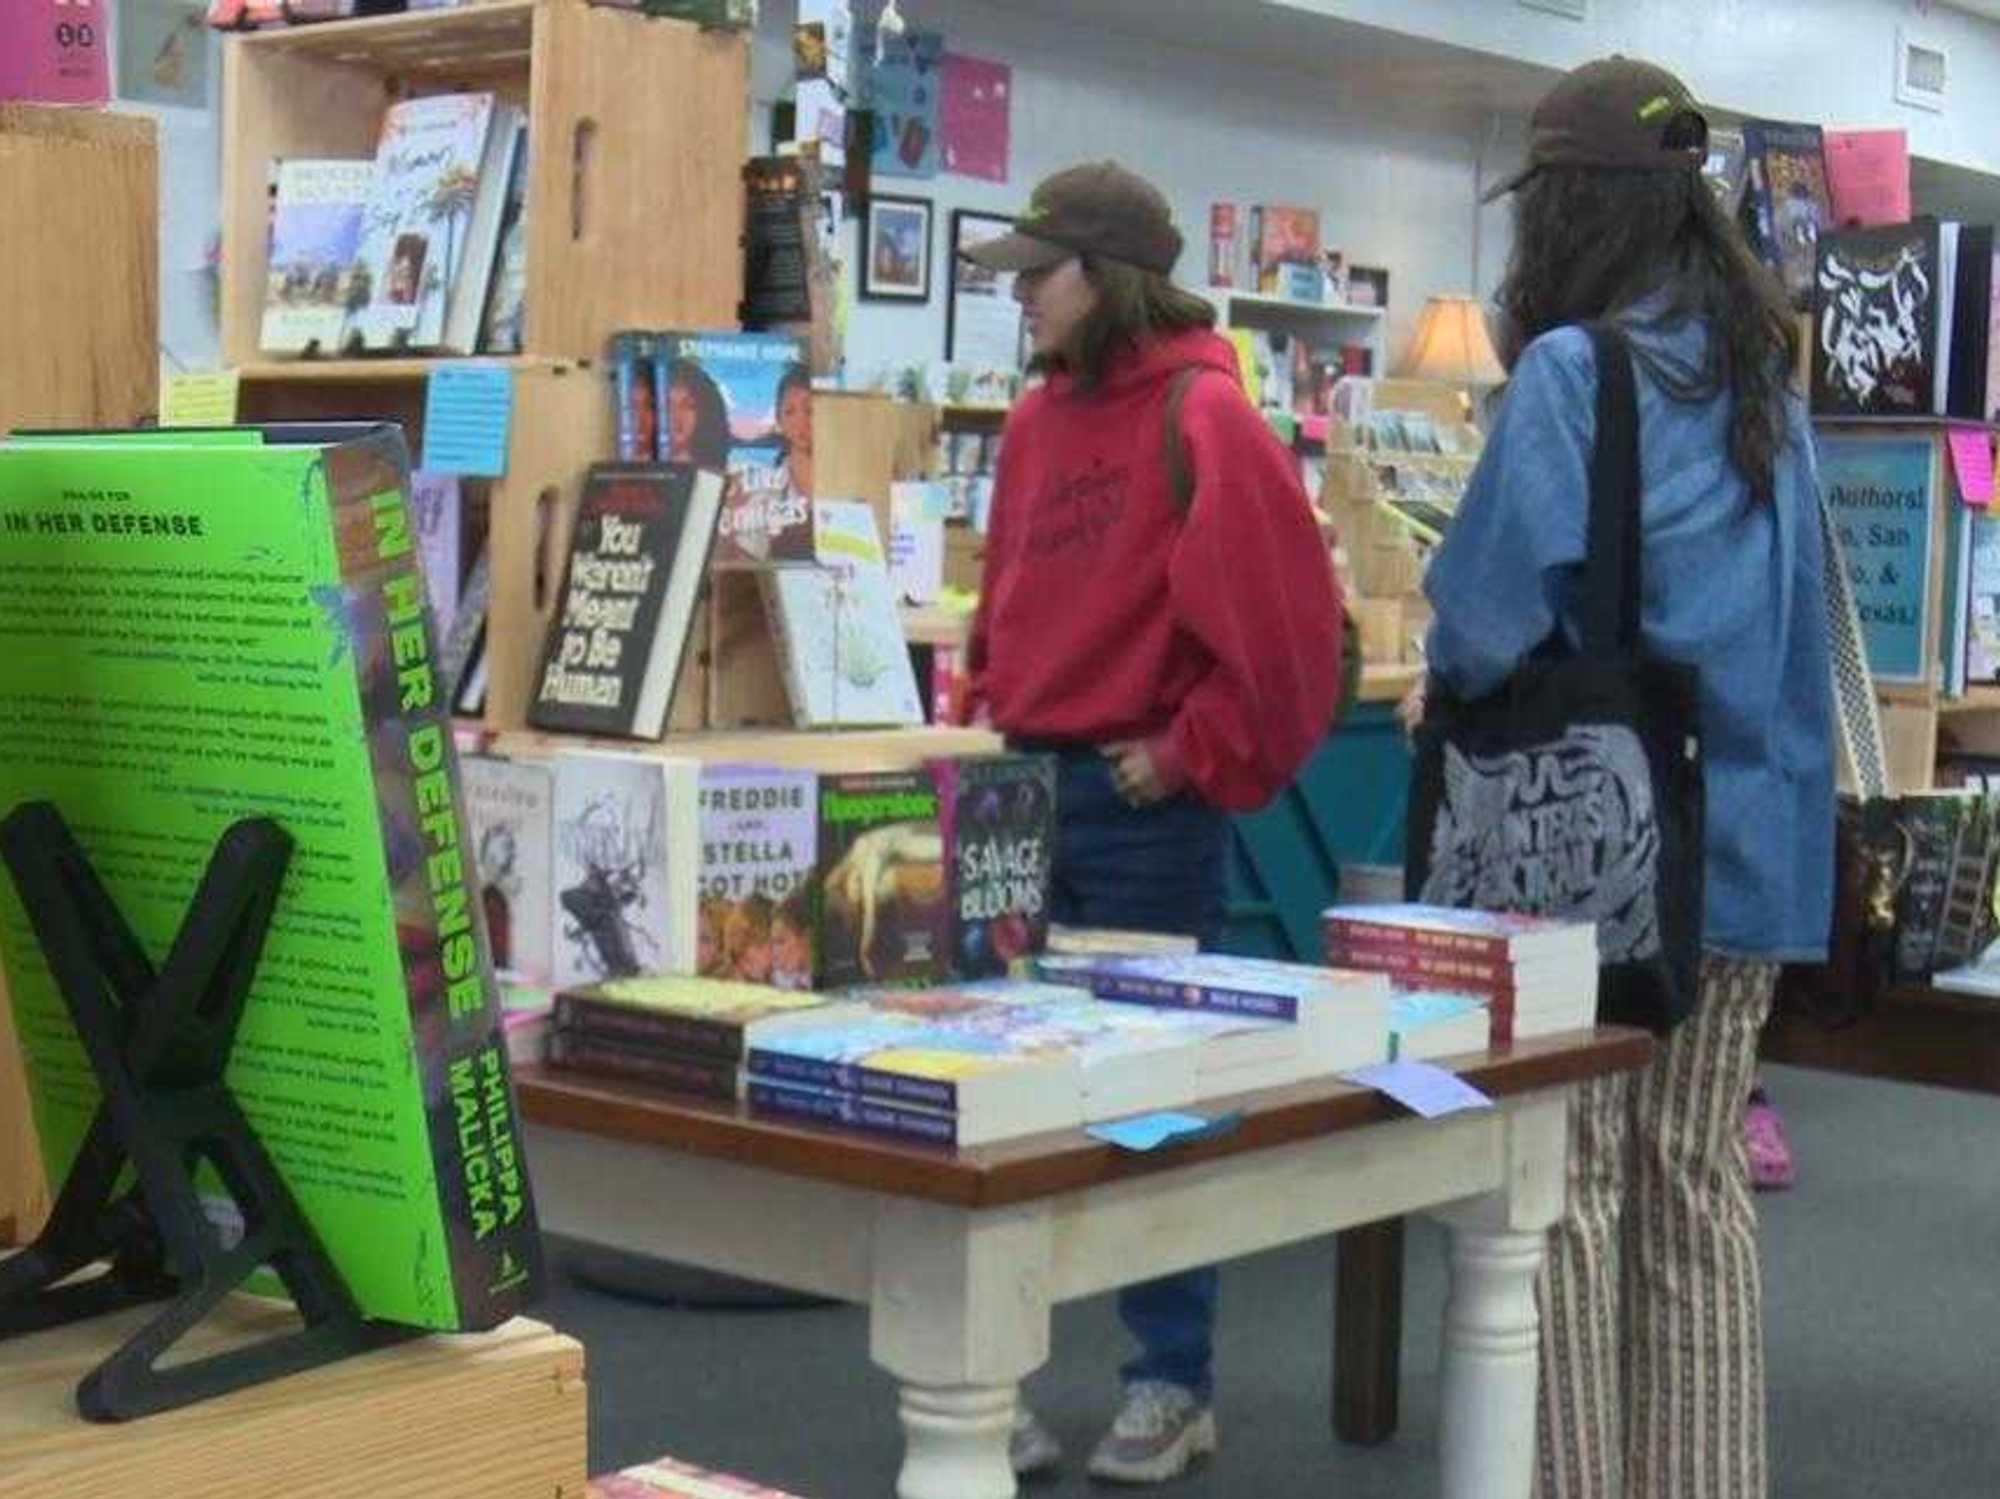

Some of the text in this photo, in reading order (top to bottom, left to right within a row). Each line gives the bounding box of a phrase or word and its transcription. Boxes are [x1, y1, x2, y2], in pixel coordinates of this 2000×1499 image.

[4, 513, 204, 537] IN HER DEFENSE
[371, 489, 411, 560] IN
[600, 514, 642, 555] You
[383, 573, 433, 712] HER
[408, 724, 484, 1019] DEFENSE
[703, 840, 793, 864] STELLA
[449, 1056, 498, 1241] MALICKA
[479, 1047, 522, 1225] PHILIPPA
